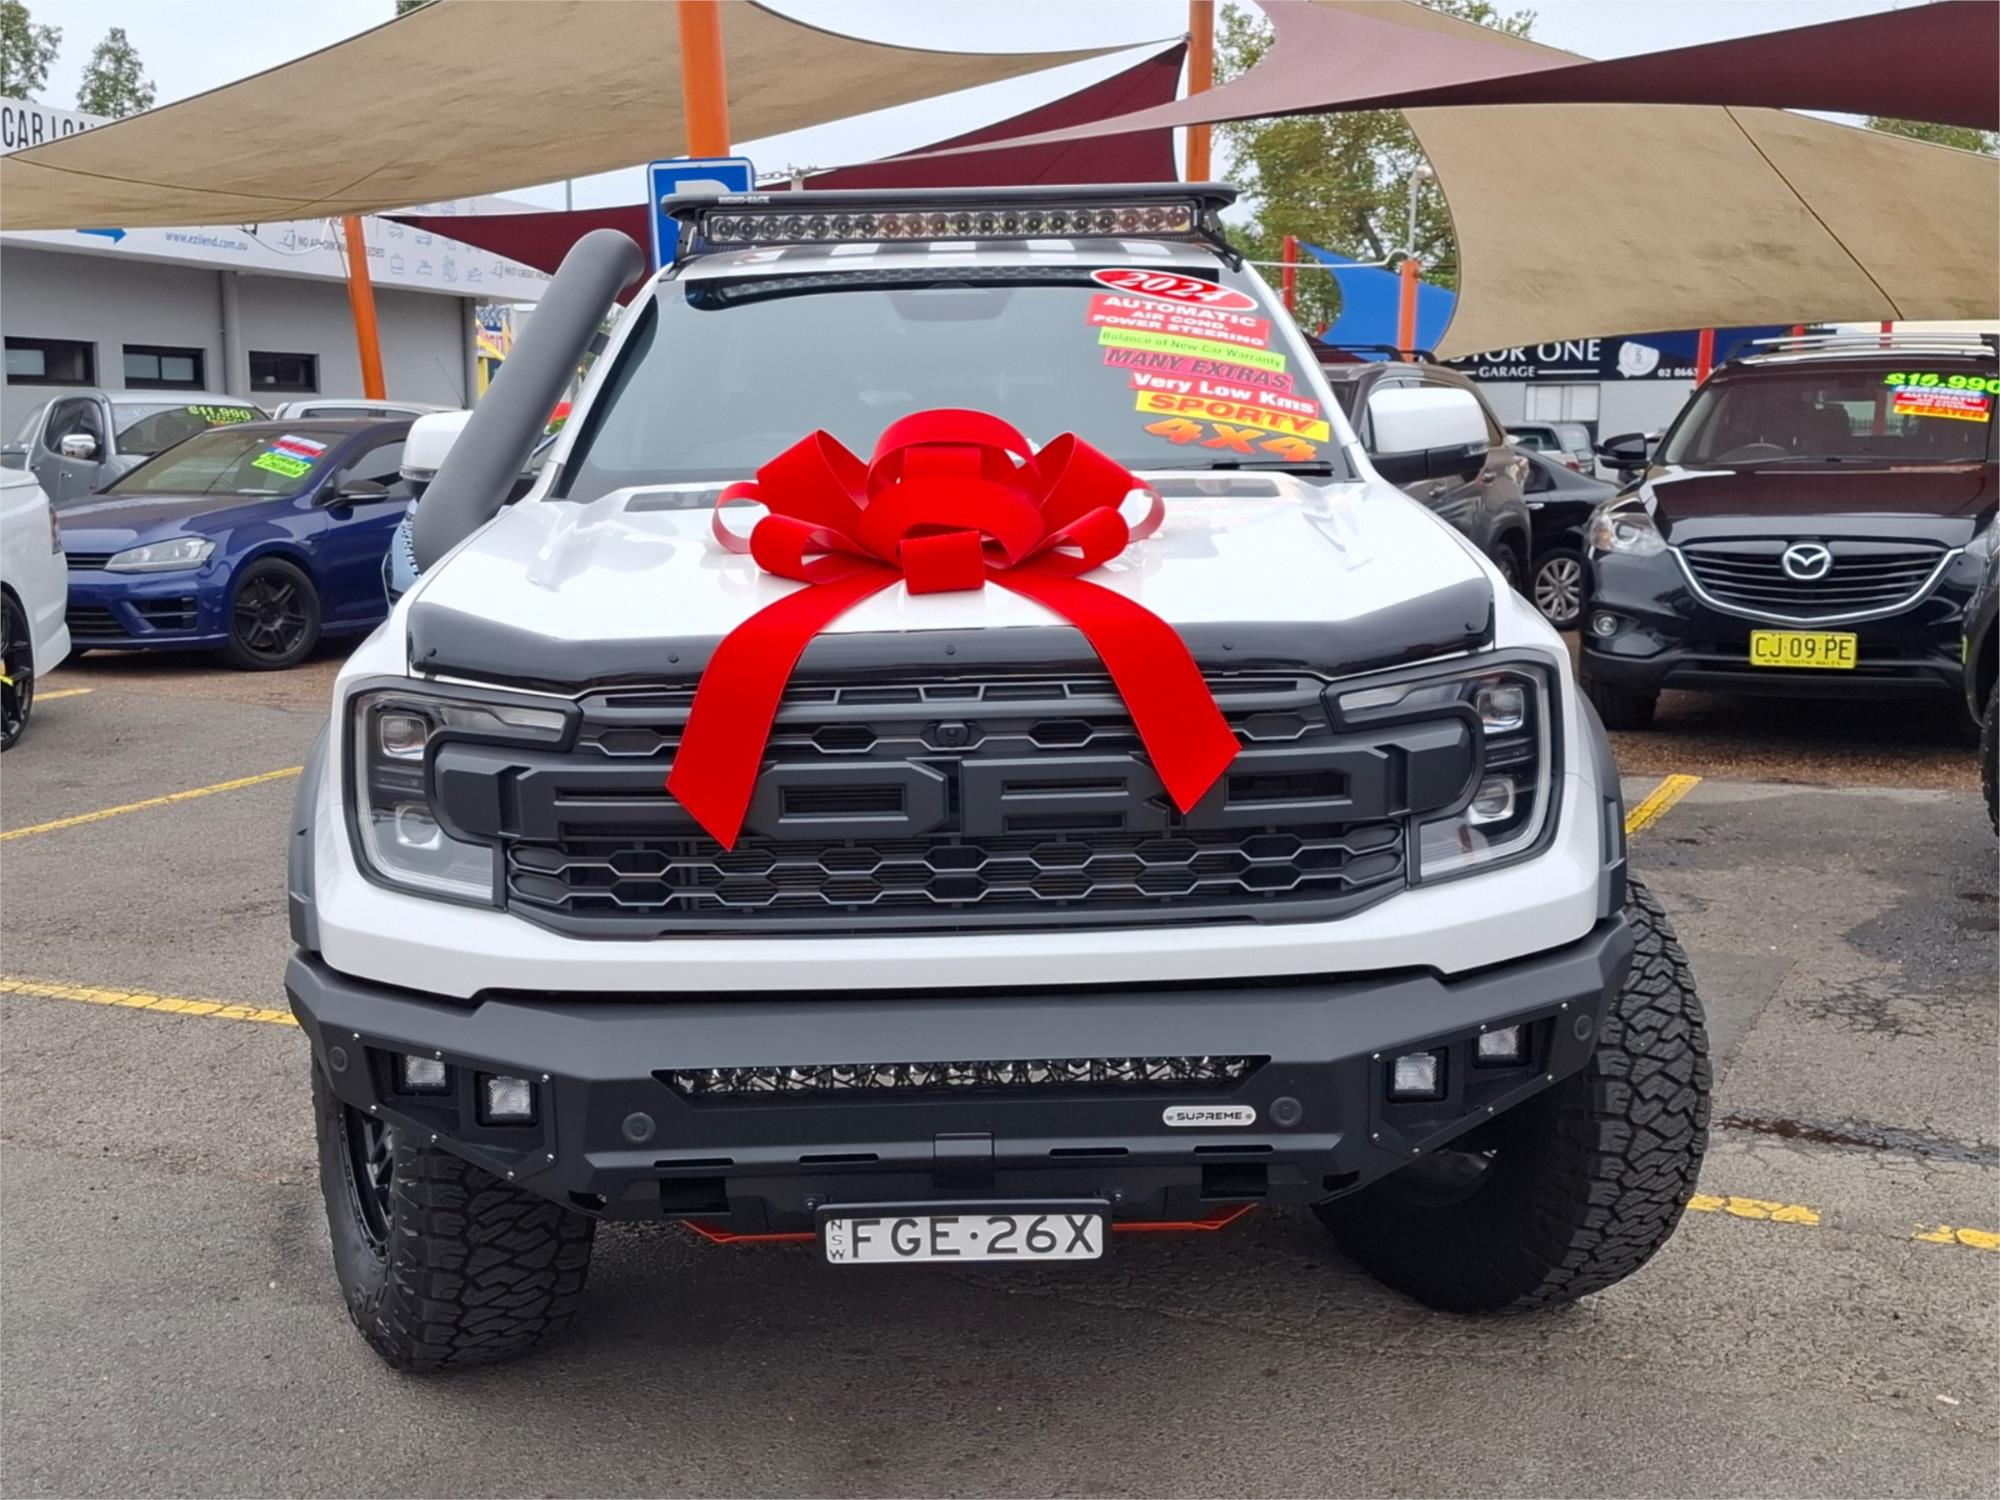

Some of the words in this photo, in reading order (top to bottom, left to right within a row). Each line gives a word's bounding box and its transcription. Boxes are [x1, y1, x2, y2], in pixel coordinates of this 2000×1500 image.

[2, 106, 43, 149] CAR
[165, 230, 249, 252] www.ezilend.com.au
[1112, 271, 1225, 302] 2024
[1103, 296, 1257, 328] AUTOMATIC
[1132, 310, 1164, 322] AIR
[1171, 314, 1230, 331] COND.
[1092, 313, 1161, 330] POWER
[1166, 322, 1265, 346] STEERING
[1102, 330, 1152, 346] Balance
[1155, 337, 1169, 347] of
[1172, 340, 1197, 352] New
[1201, 344, 1223, 355] Car
[1226, 348, 1282, 368] Warranty
[1537, 339, 1602, 362] ONE
[1106, 348, 1186, 371] MANY
[1190, 359, 1291, 389] EXTRAS
[1478, 366, 1536, 378] GARAGE
[1132, 372, 1192, 394] Very
[1200, 380, 1250, 401] Low
[1259, 391, 1315, 415] Kms
[1148, 394, 1320, 433] SPORTY
[1143, 417, 1319, 462] 4X4
[1176, 1111, 1243, 1121] SUPREME
